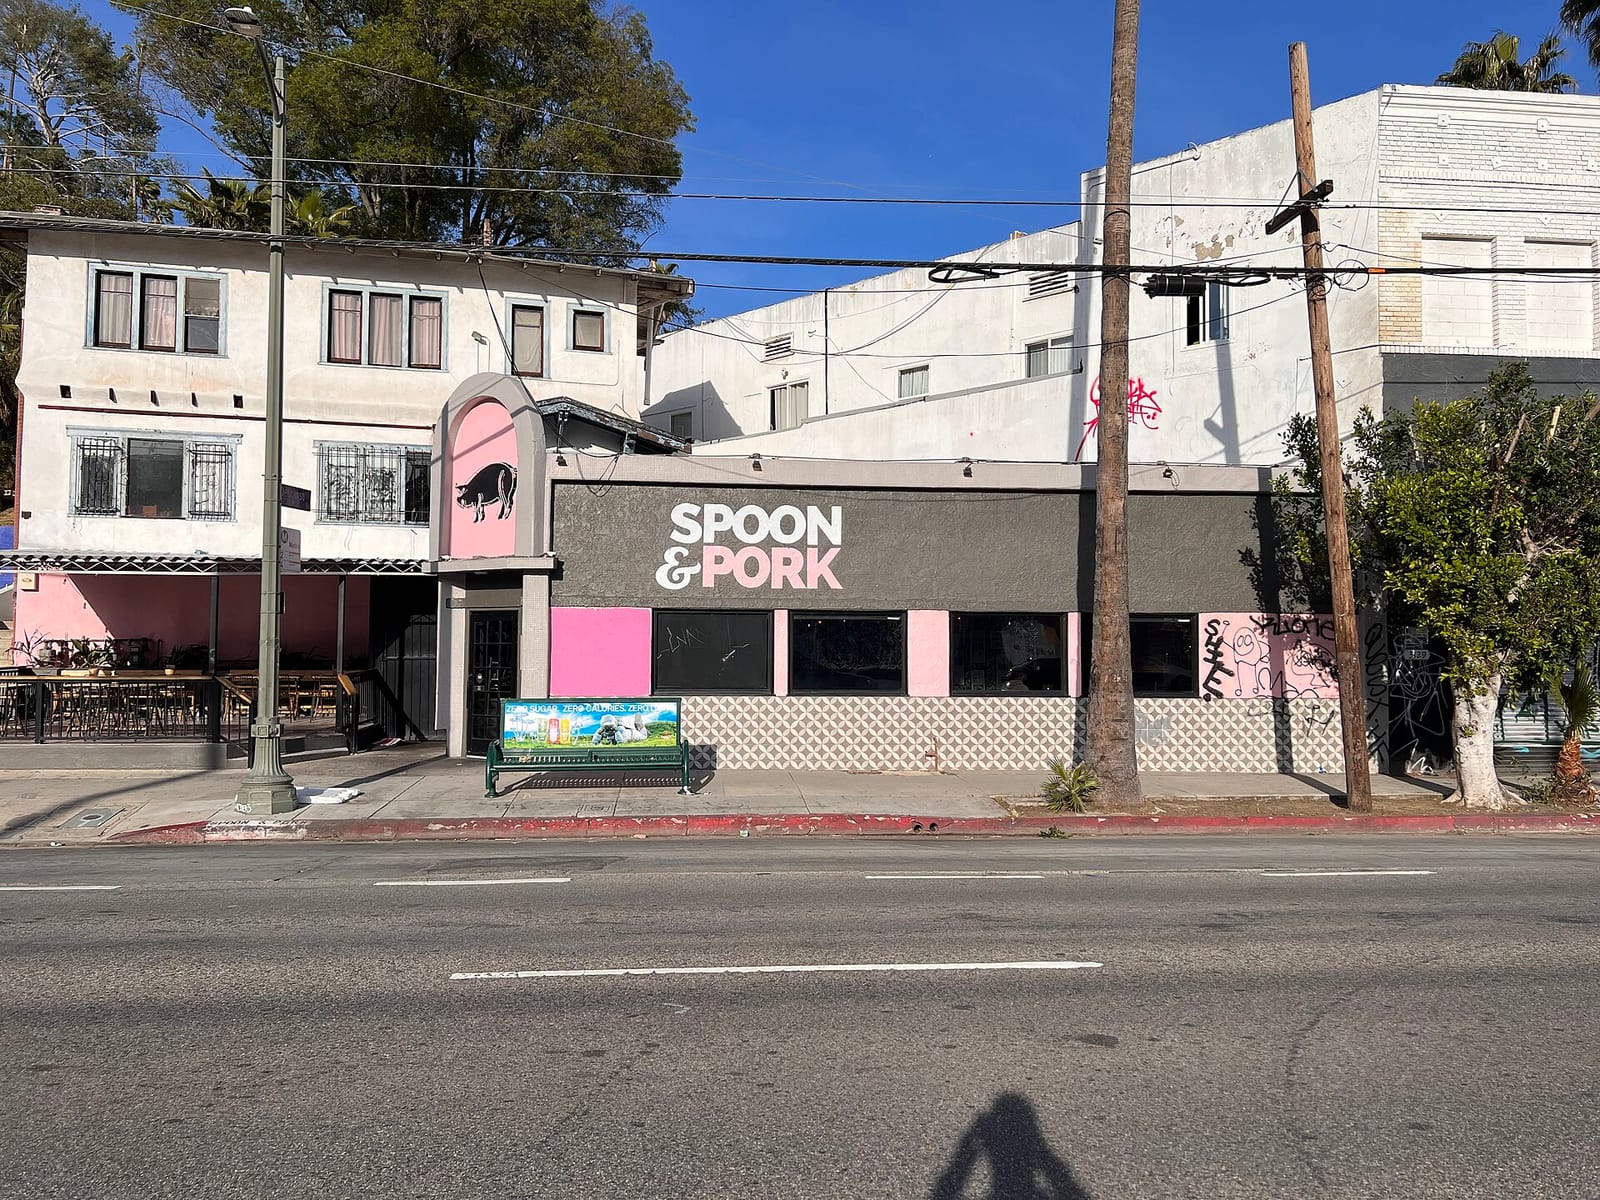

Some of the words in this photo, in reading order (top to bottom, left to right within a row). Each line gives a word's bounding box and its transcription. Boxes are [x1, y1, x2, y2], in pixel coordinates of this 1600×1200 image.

[669, 502, 842, 545] SPOON
[655, 546, 701, 590] &
[702, 545, 843, 589] PORK
[627, 704, 648, 712] ZERO
